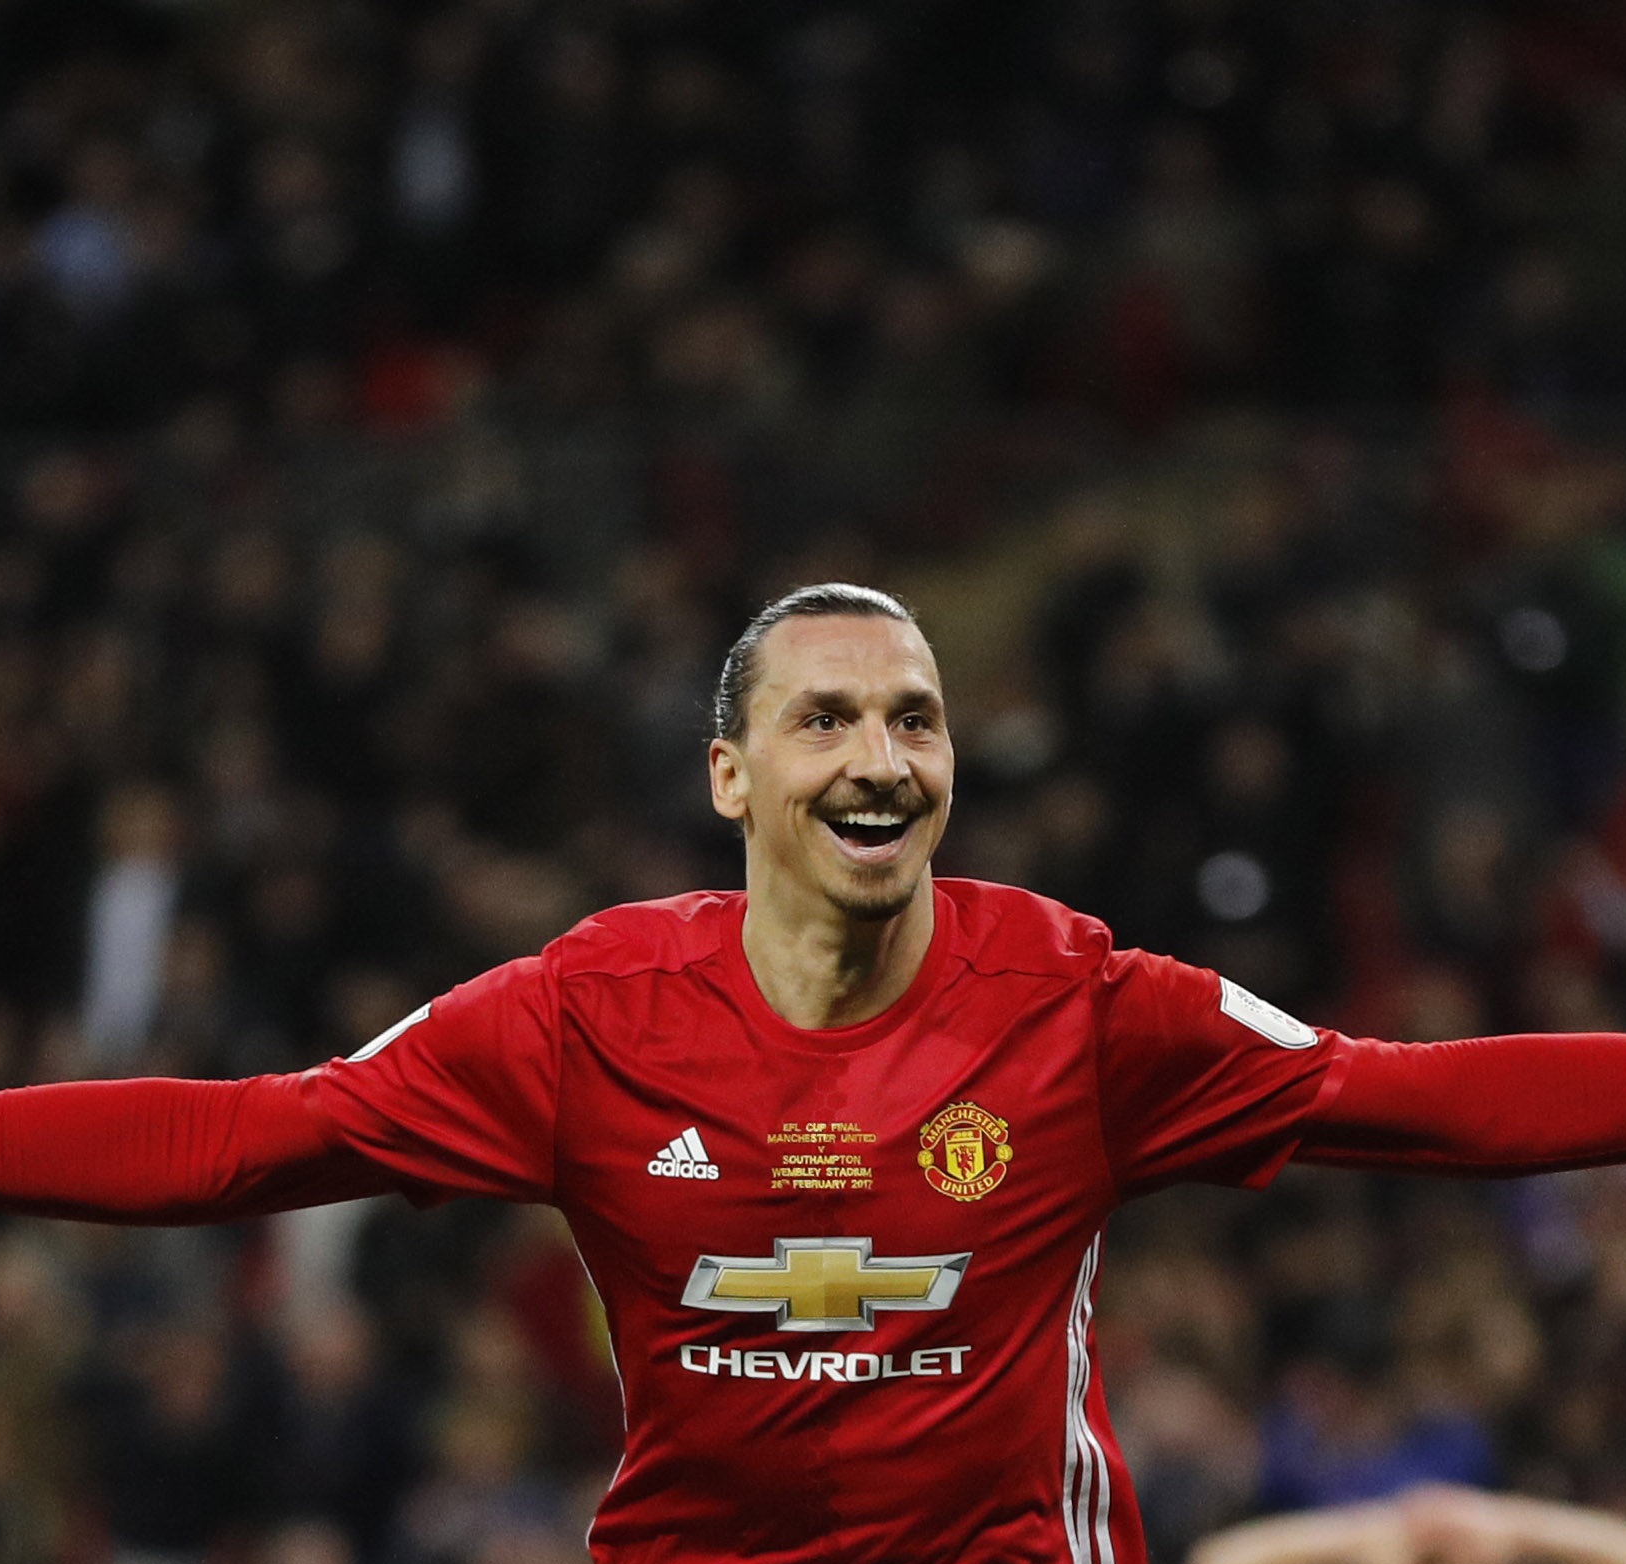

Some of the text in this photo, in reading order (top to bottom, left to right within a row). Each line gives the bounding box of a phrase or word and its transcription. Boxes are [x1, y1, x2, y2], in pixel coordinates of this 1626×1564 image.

[783, 1123, 861, 1132] EFL CUP FINAL
[926, 1109, 1001, 1143] MANCHESTER
[767, 1133, 876, 1143] MANCHESTER UNITED
[782, 1155, 861, 1165] SOUTHAMPTON
[647, 1159, 720, 1180] adidas
[771, 1167, 872, 1178] WEMBLEY STADIUM
[793, 1179, 846, 1189] FEBRUARY
[850, 1179, 874, 1190] 2017
[941, 1176, 994, 1194] UNITED
[680, 1344, 972, 1382] CHEVROLET
